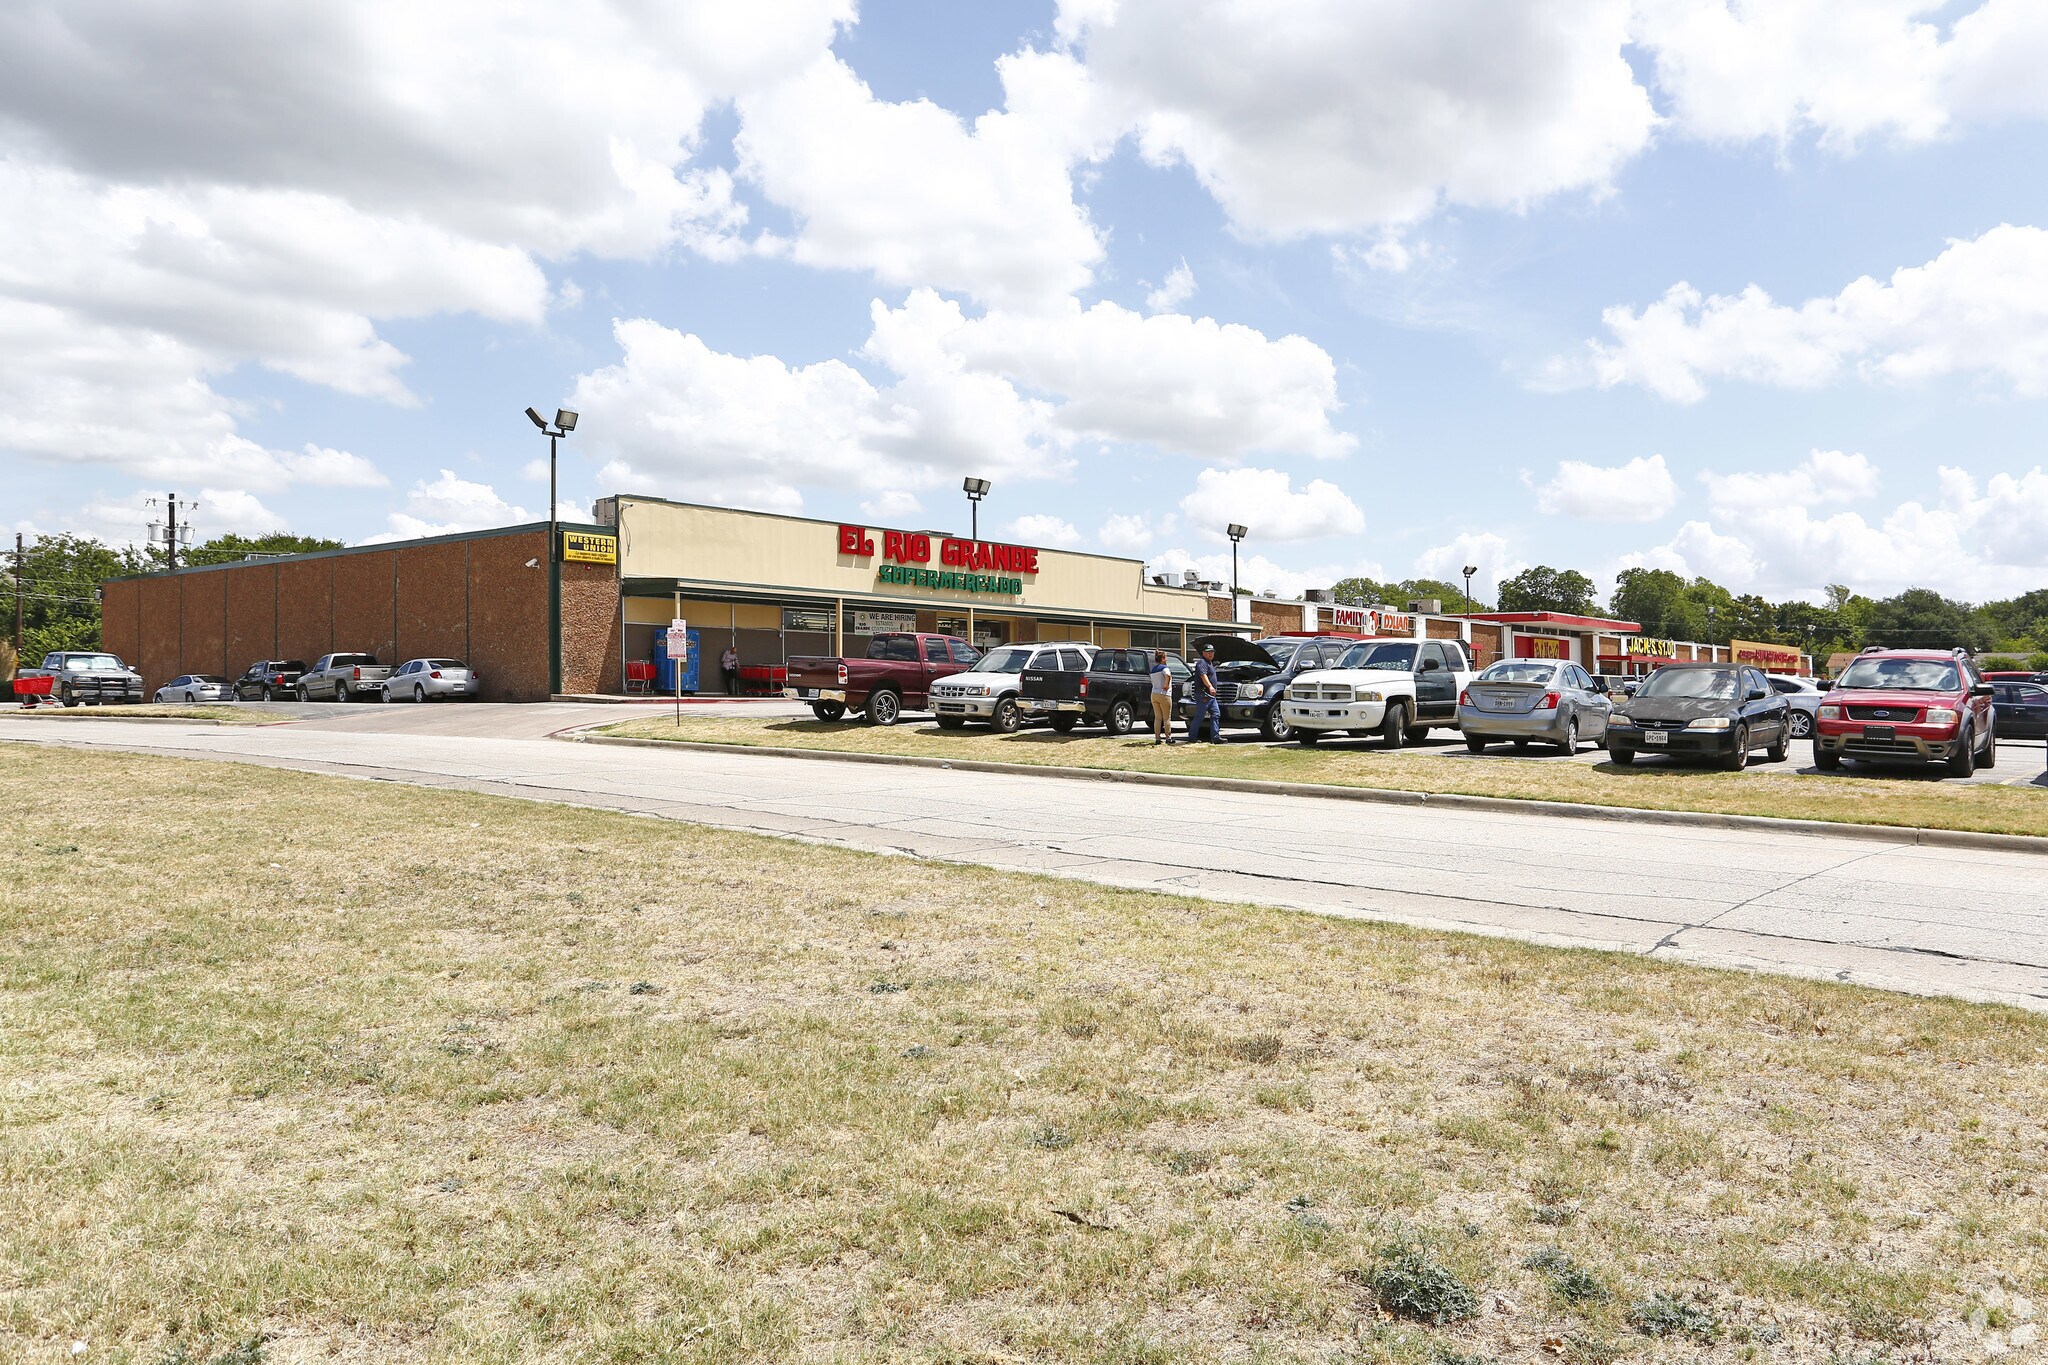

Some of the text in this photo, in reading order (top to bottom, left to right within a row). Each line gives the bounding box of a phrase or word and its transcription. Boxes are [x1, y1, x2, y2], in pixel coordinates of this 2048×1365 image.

[569, 535, 613, 546] WESTERN
[583, 543, 613, 553] UNION
[838, 525, 1039, 574] EL RIO GRANDE
[879, 564, 1022, 595] SUPERMERCADO
[869, 612, 916, 622] WE ARE HIRING
[1336, 609, 1363, 626] FAMILY
